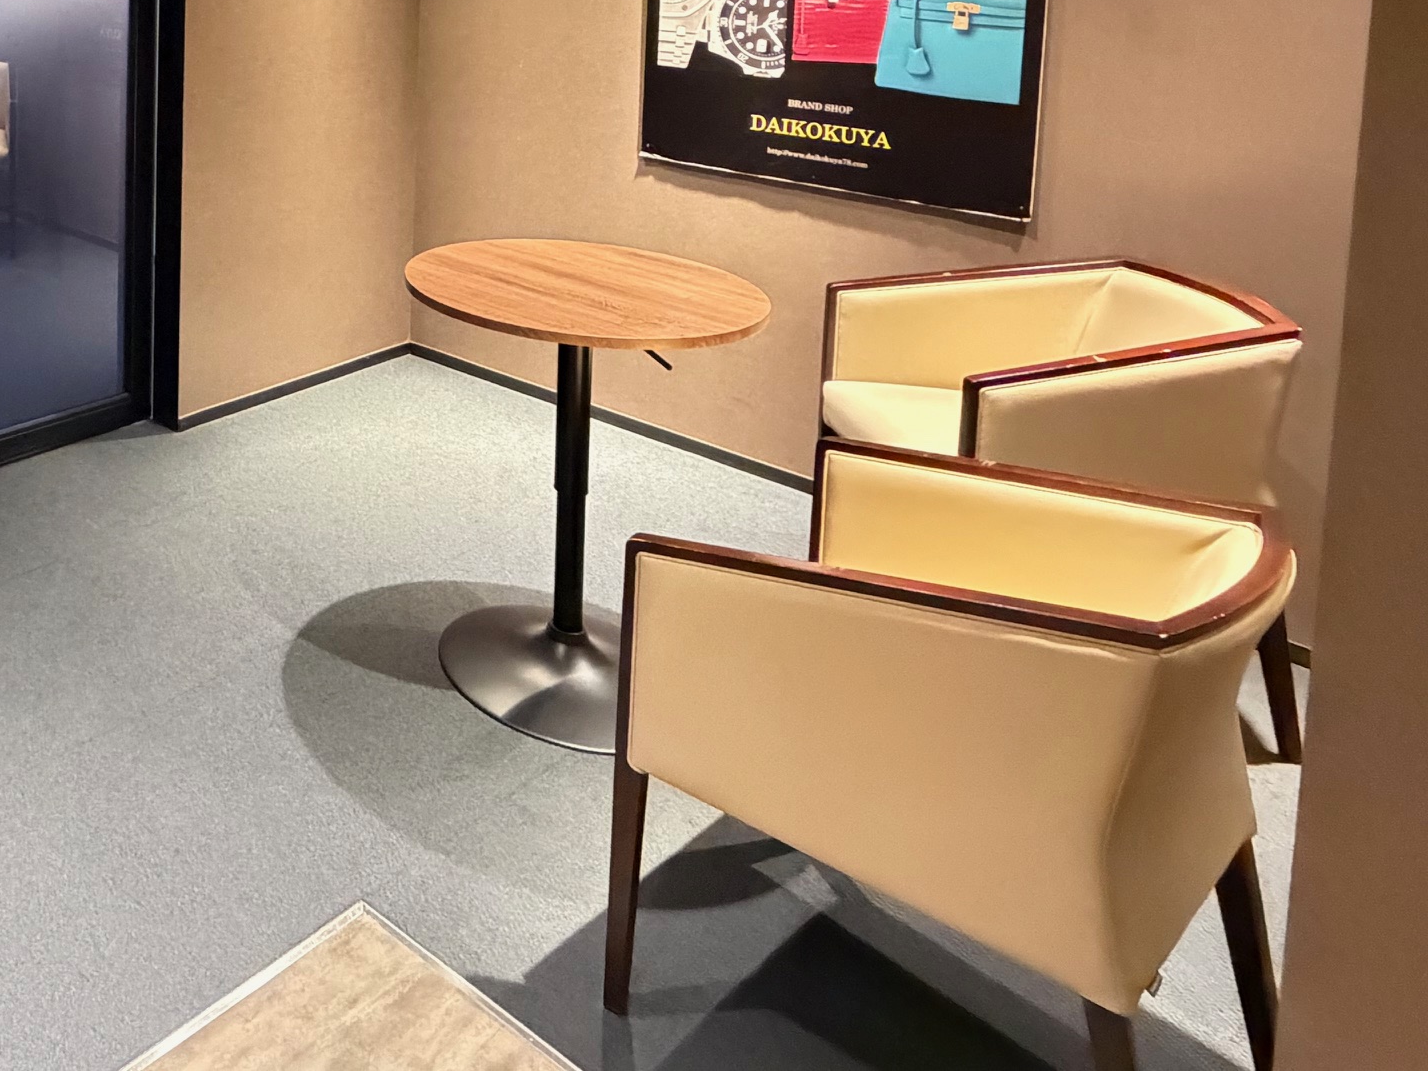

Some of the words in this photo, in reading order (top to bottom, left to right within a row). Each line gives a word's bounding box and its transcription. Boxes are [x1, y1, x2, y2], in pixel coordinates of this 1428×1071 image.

[787, 98, 822, 111] BRAND
[824, 102, 854, 115] SHOP
[749, 113, 892, 150] DAIKOKUYA
